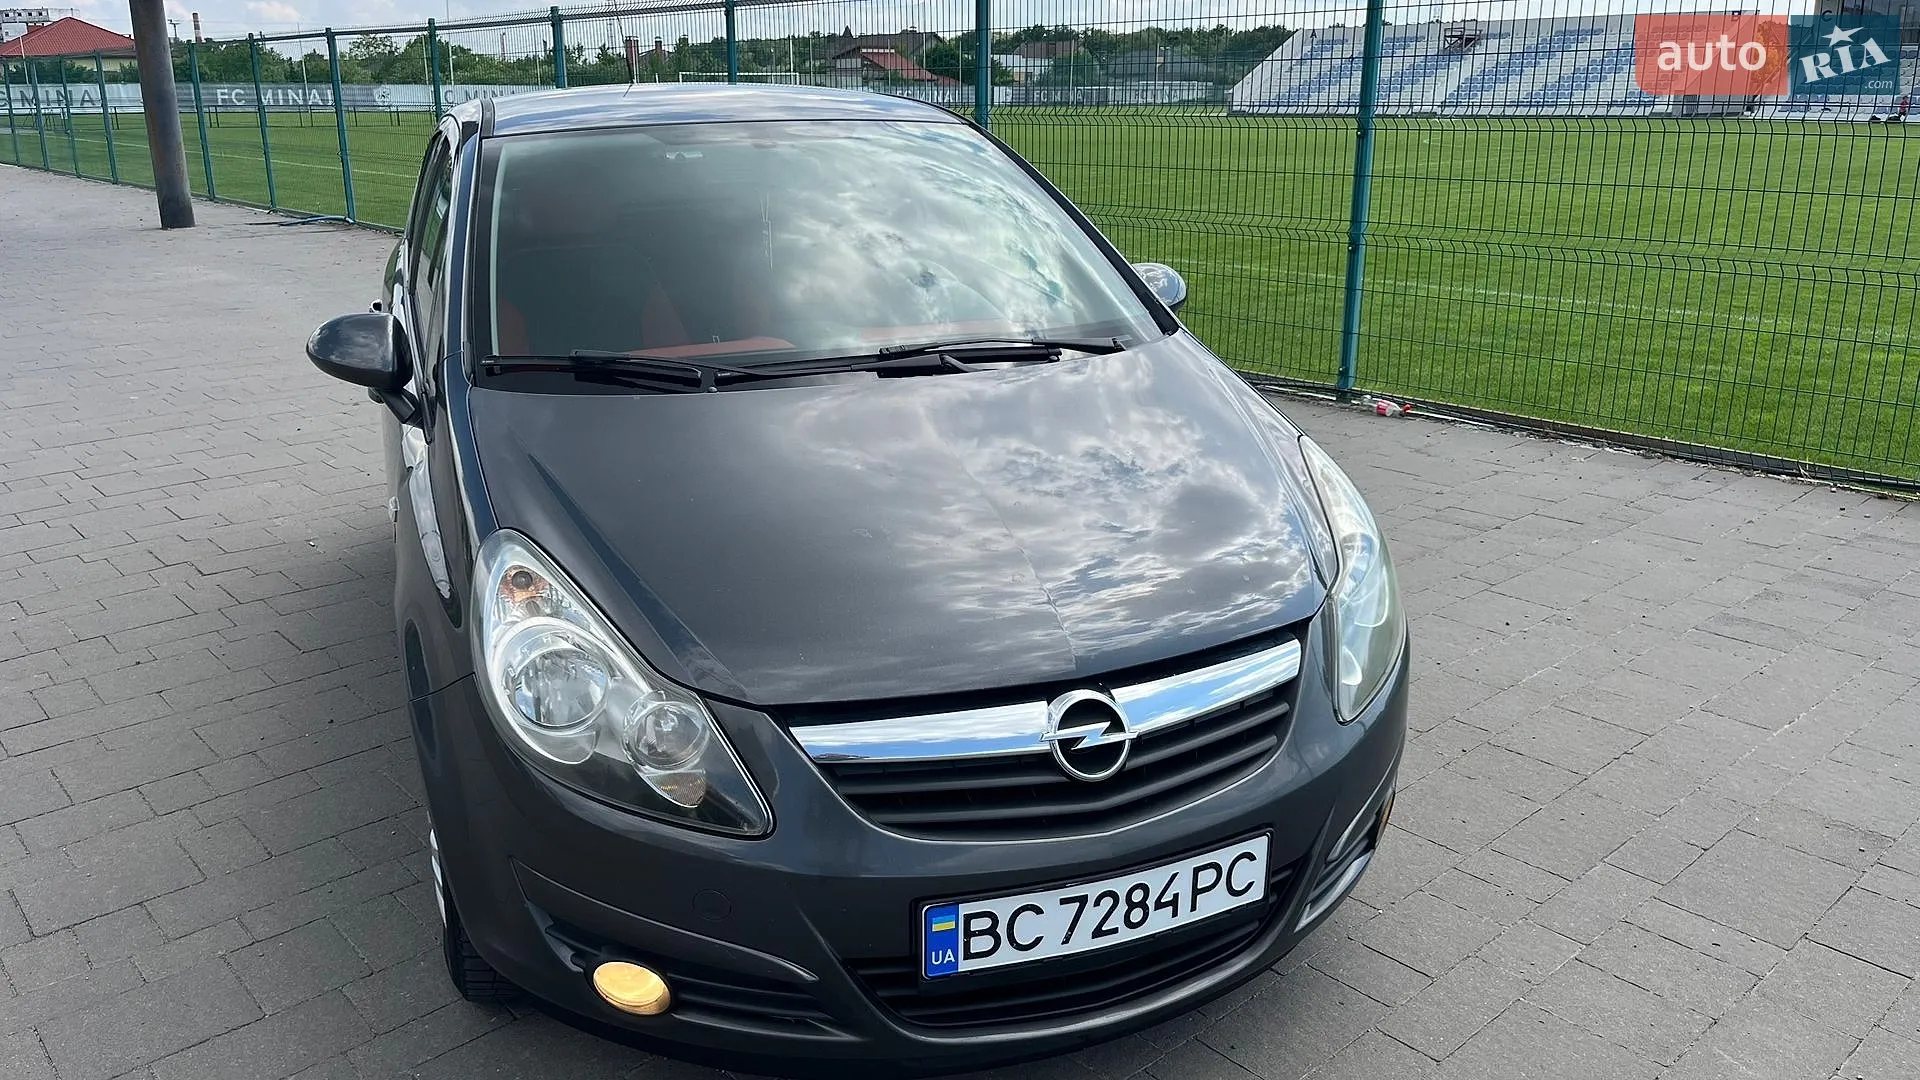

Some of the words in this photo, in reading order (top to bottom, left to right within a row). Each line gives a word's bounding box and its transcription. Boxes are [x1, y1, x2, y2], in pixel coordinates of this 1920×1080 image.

[20, 90, 96, 107] MINA
[216, 89, 246, 105] FC
[962, 903, 1045, 961] BC
[1059, 871, 1180, 946] 7284
[1190, 851, 1257, 913] PC
[932, 948, 956, 966] UA
